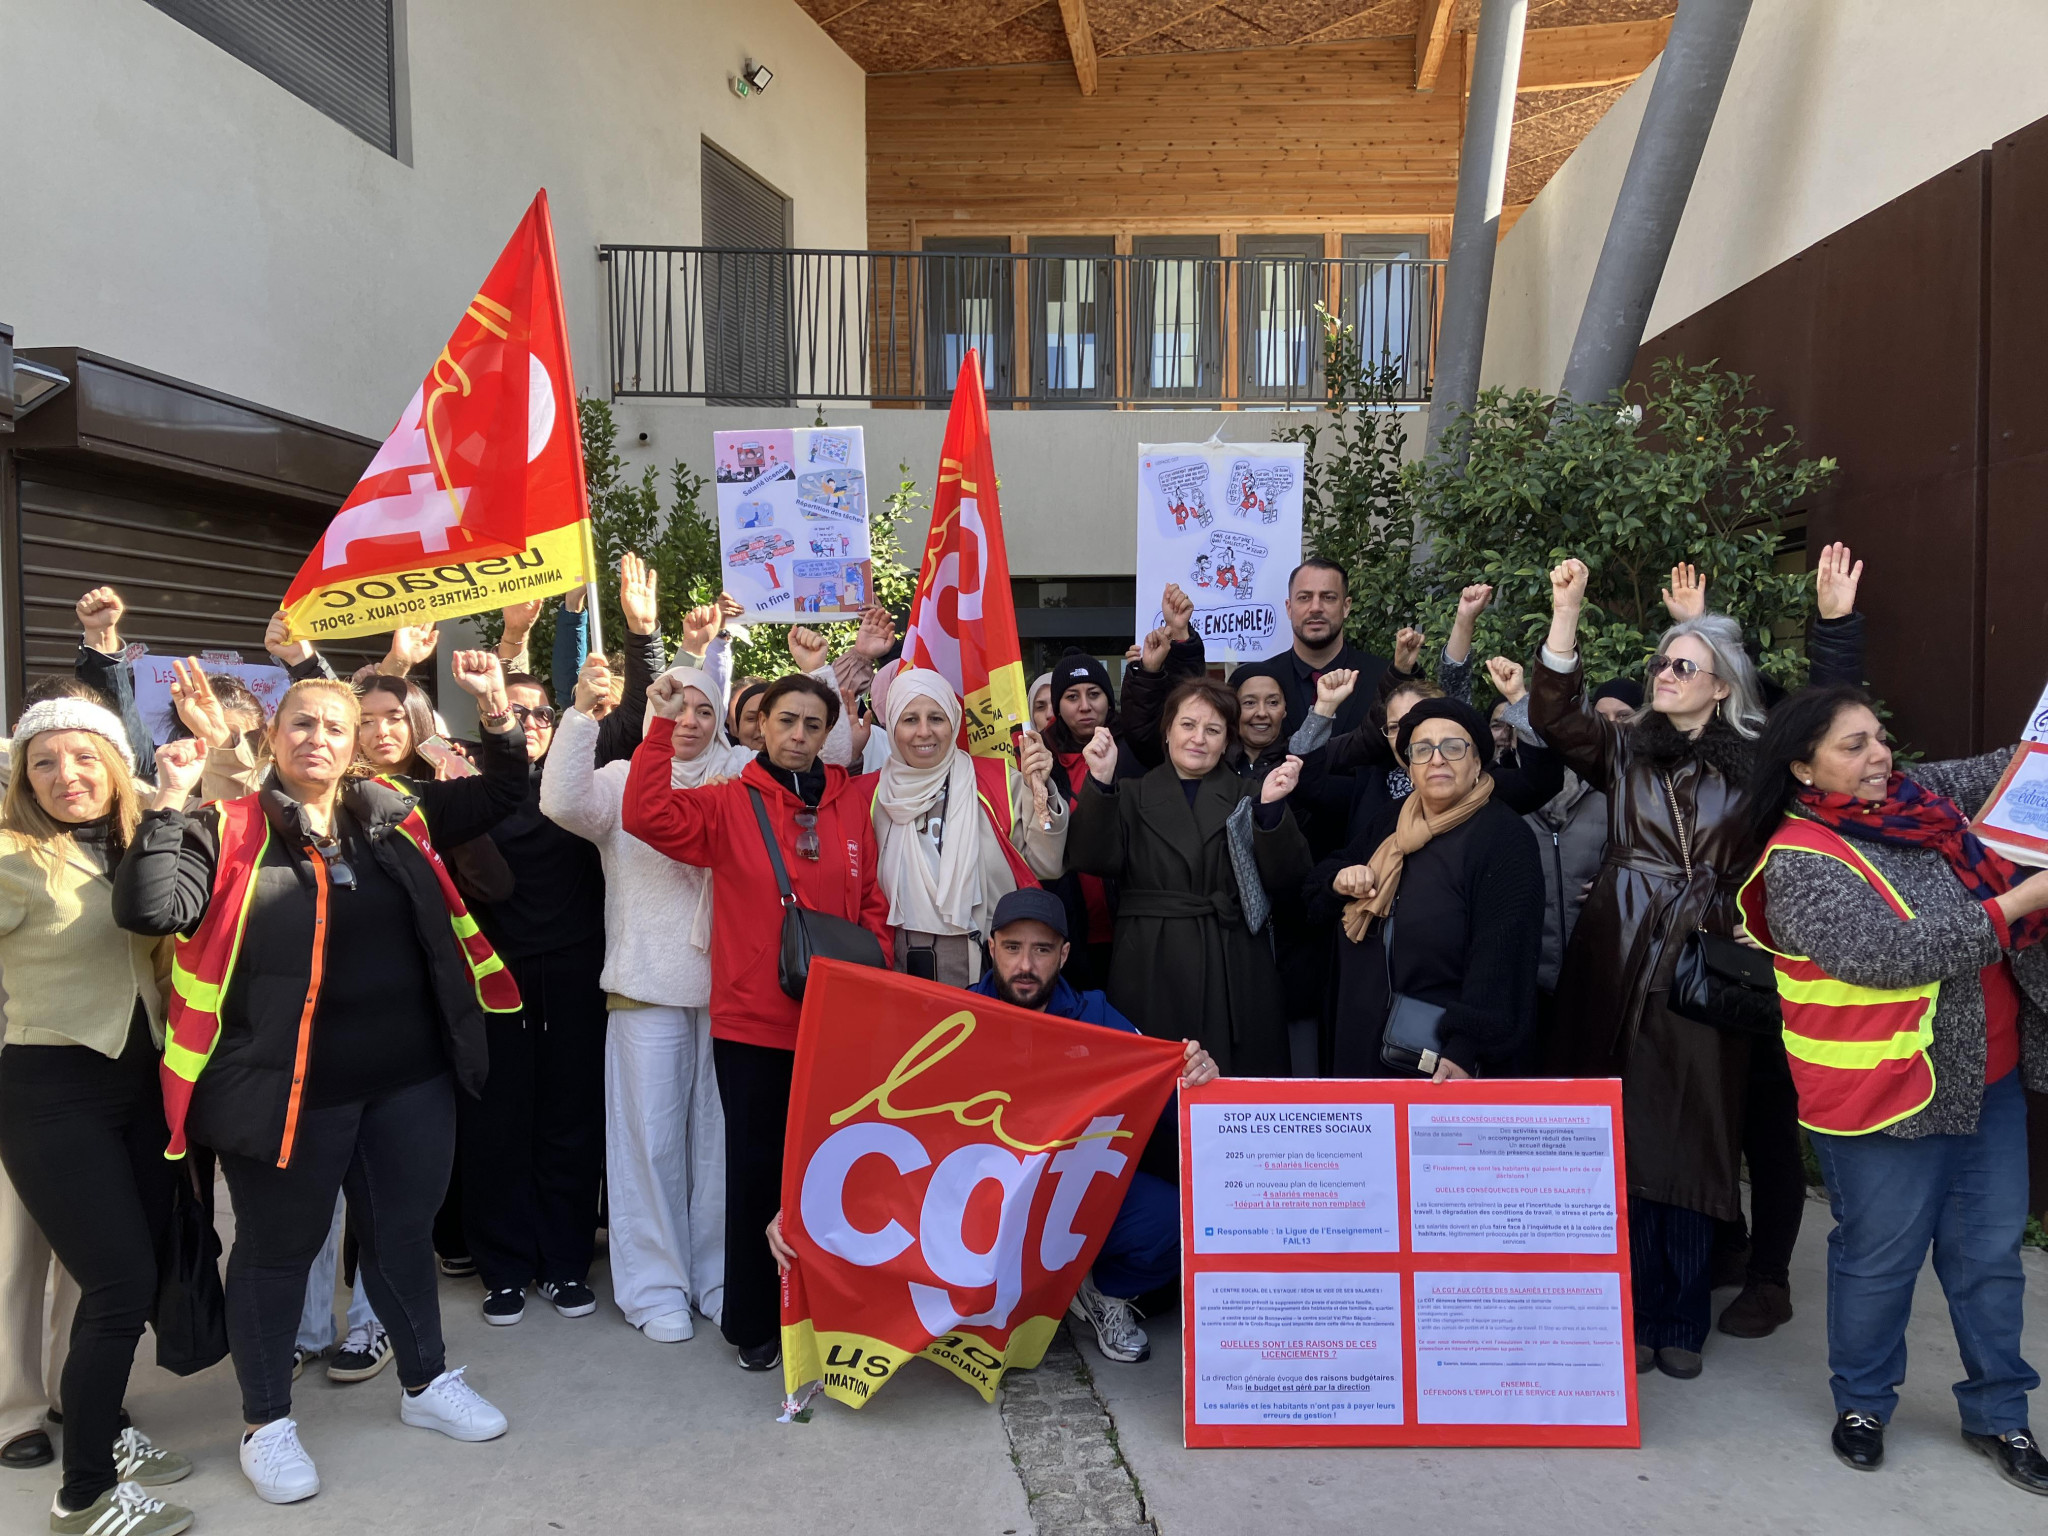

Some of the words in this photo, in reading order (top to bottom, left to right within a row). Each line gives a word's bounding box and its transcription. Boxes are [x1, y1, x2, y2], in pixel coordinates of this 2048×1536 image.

[742, 480, 765, 497] Salarié
[764, 464, 789, 482] licencié
[796, 498, 829, 514] Répartition
[830, 509, 842, 518] des
[843, 511, 864, 523] tâches
[756, 599, 769, 612] In
[769, 590, 791, 606] fine
[153, 666, 176, 684] LES
[830, 1010, 1133, 1152] la
[1224, 1113, 1252, 1121] STOP
[1254, 1113, 1276, 1121] AUX
[1279, 1113, 1363, 1121] LICENCIEMENTS
[1219, 1125, 1248, 1133] DANS
[1250, 1125, 1271, 1133] LES
[1273, 1125, 1322, 1133] CENTRES
[1324, 1125, 1371, 1133] SOCIAUX
[1257, 1152, 1286, 1160] premier
[1287, 1152, 1303, 1160] plan
[1290, 1181, 1306, 1189] plan
[801, 1114, 1128, 1337] cgt
[1220, 1341, 1260, 1349] QUELLES
[932, 1347, 989, 1385] SOCIAUX
[1244, 1375, 1275, 1383] générale
[1276, 1375, 1302, 1383] évoque
[1349, 1374, 1396, 1382] budgétaires.
[1253, 1384, 1280, 1392] budget
[1295, 1384, 1312, 1392] géré
[1303, 1412, 1331, 1420] gestion
